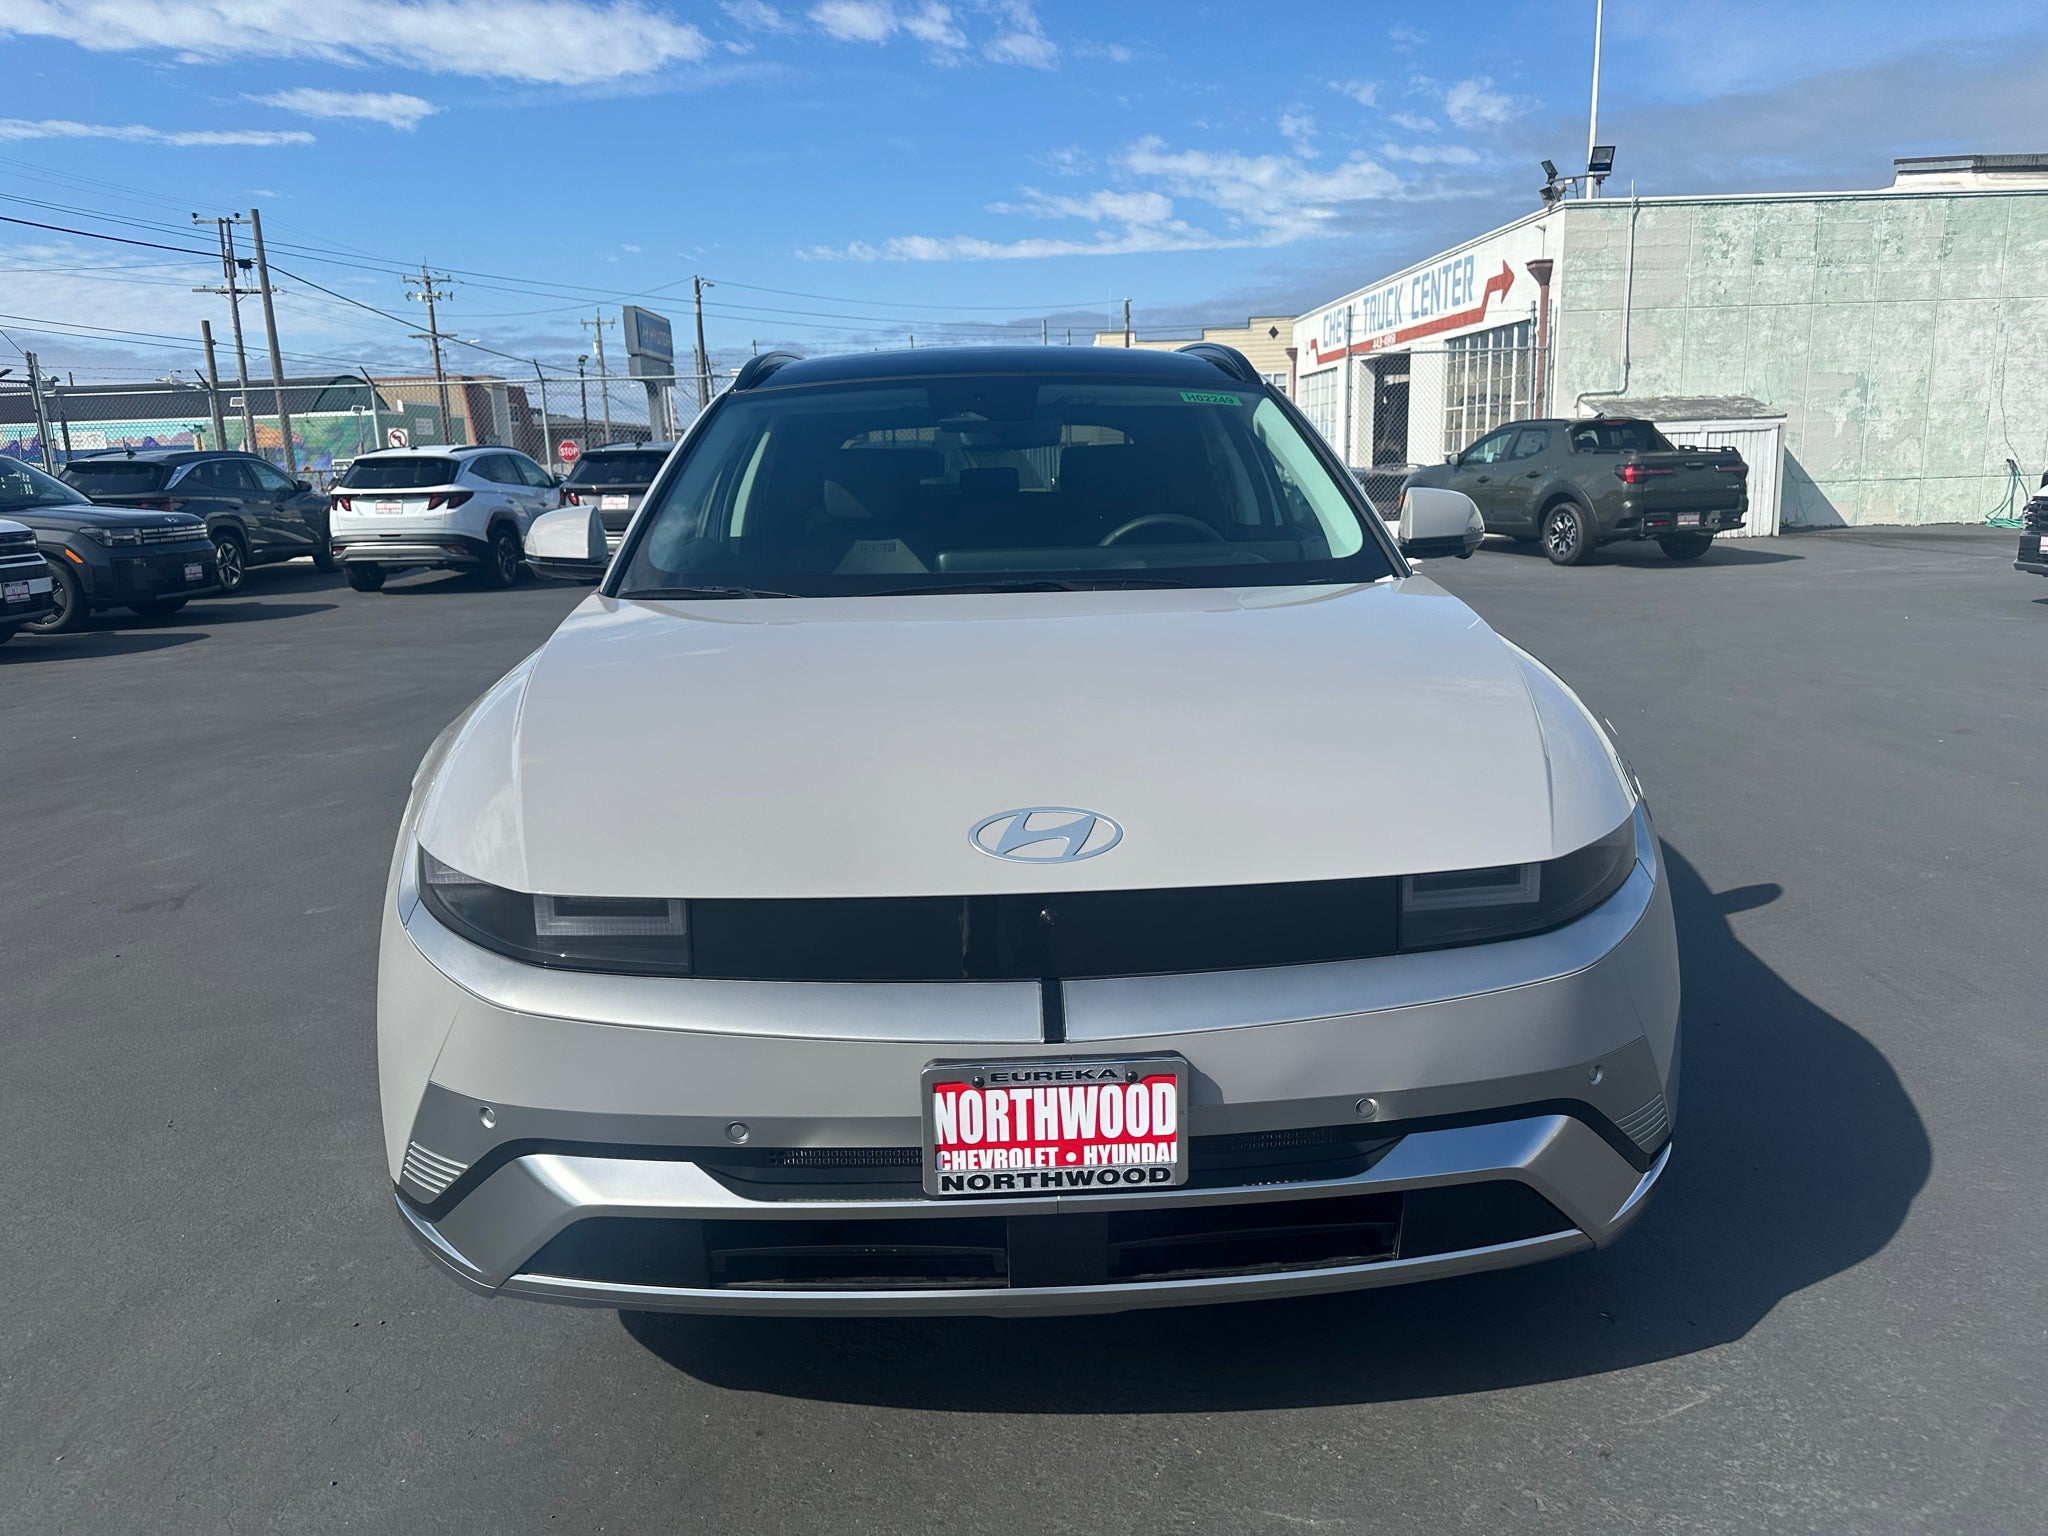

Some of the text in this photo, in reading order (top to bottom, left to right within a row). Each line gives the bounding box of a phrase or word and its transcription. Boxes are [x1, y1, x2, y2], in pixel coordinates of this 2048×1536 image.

[1363, 283, 1403, 335] TRUCK
[1411, 254, 1475, 320] CENTER
[560, 446, 578, 456] STOP
[990, 1067, 1119, 1083] EUREKA
[934, 1082, 1177, 1145] NORTHWOOD
[940, 1142, 1177, 1171] CHEVROLET HYUNDAI
[941, 1167, 1172, 1192] NORTHWOOD
